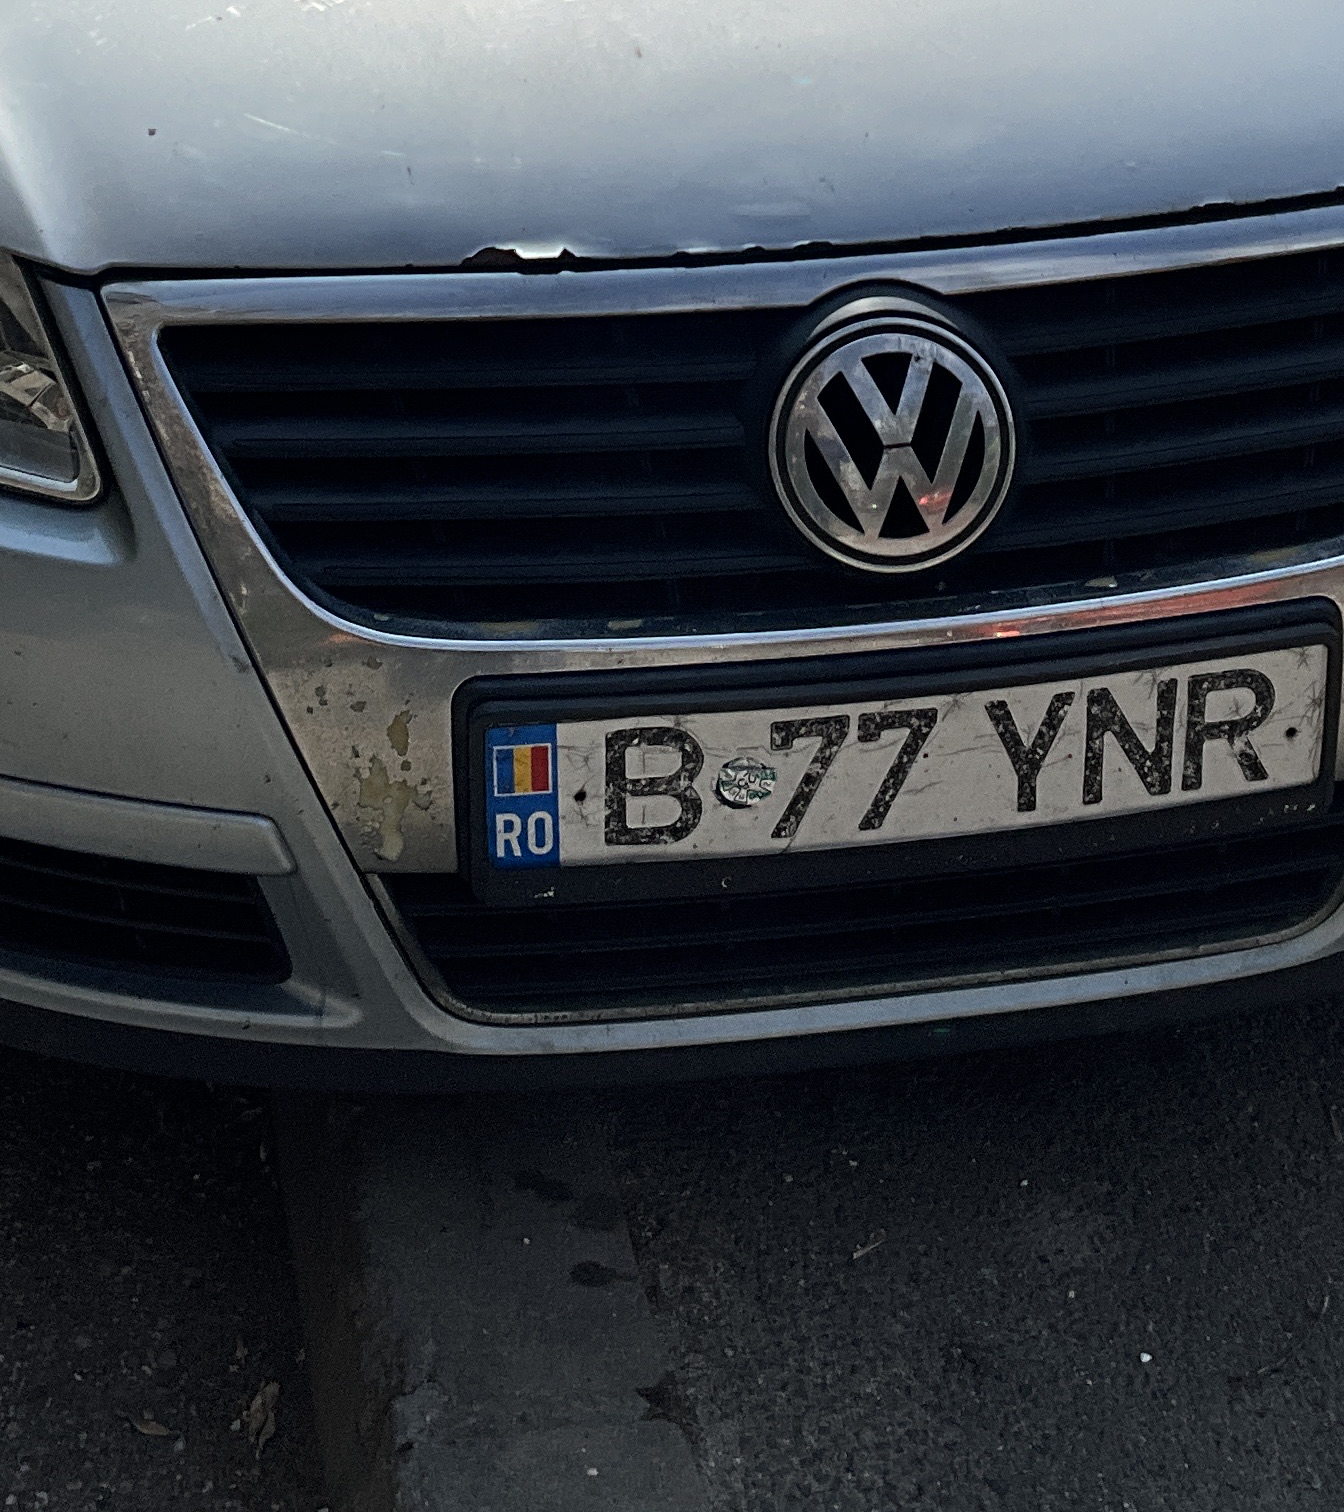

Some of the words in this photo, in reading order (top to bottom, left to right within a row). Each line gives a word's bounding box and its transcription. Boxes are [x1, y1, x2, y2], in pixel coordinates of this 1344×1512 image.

[604, 726, 705, 846] B
[769, 708, 939, 839] 77
[983, 668, 1276, 813] YNR
[494, 810, 554, 858] RO
